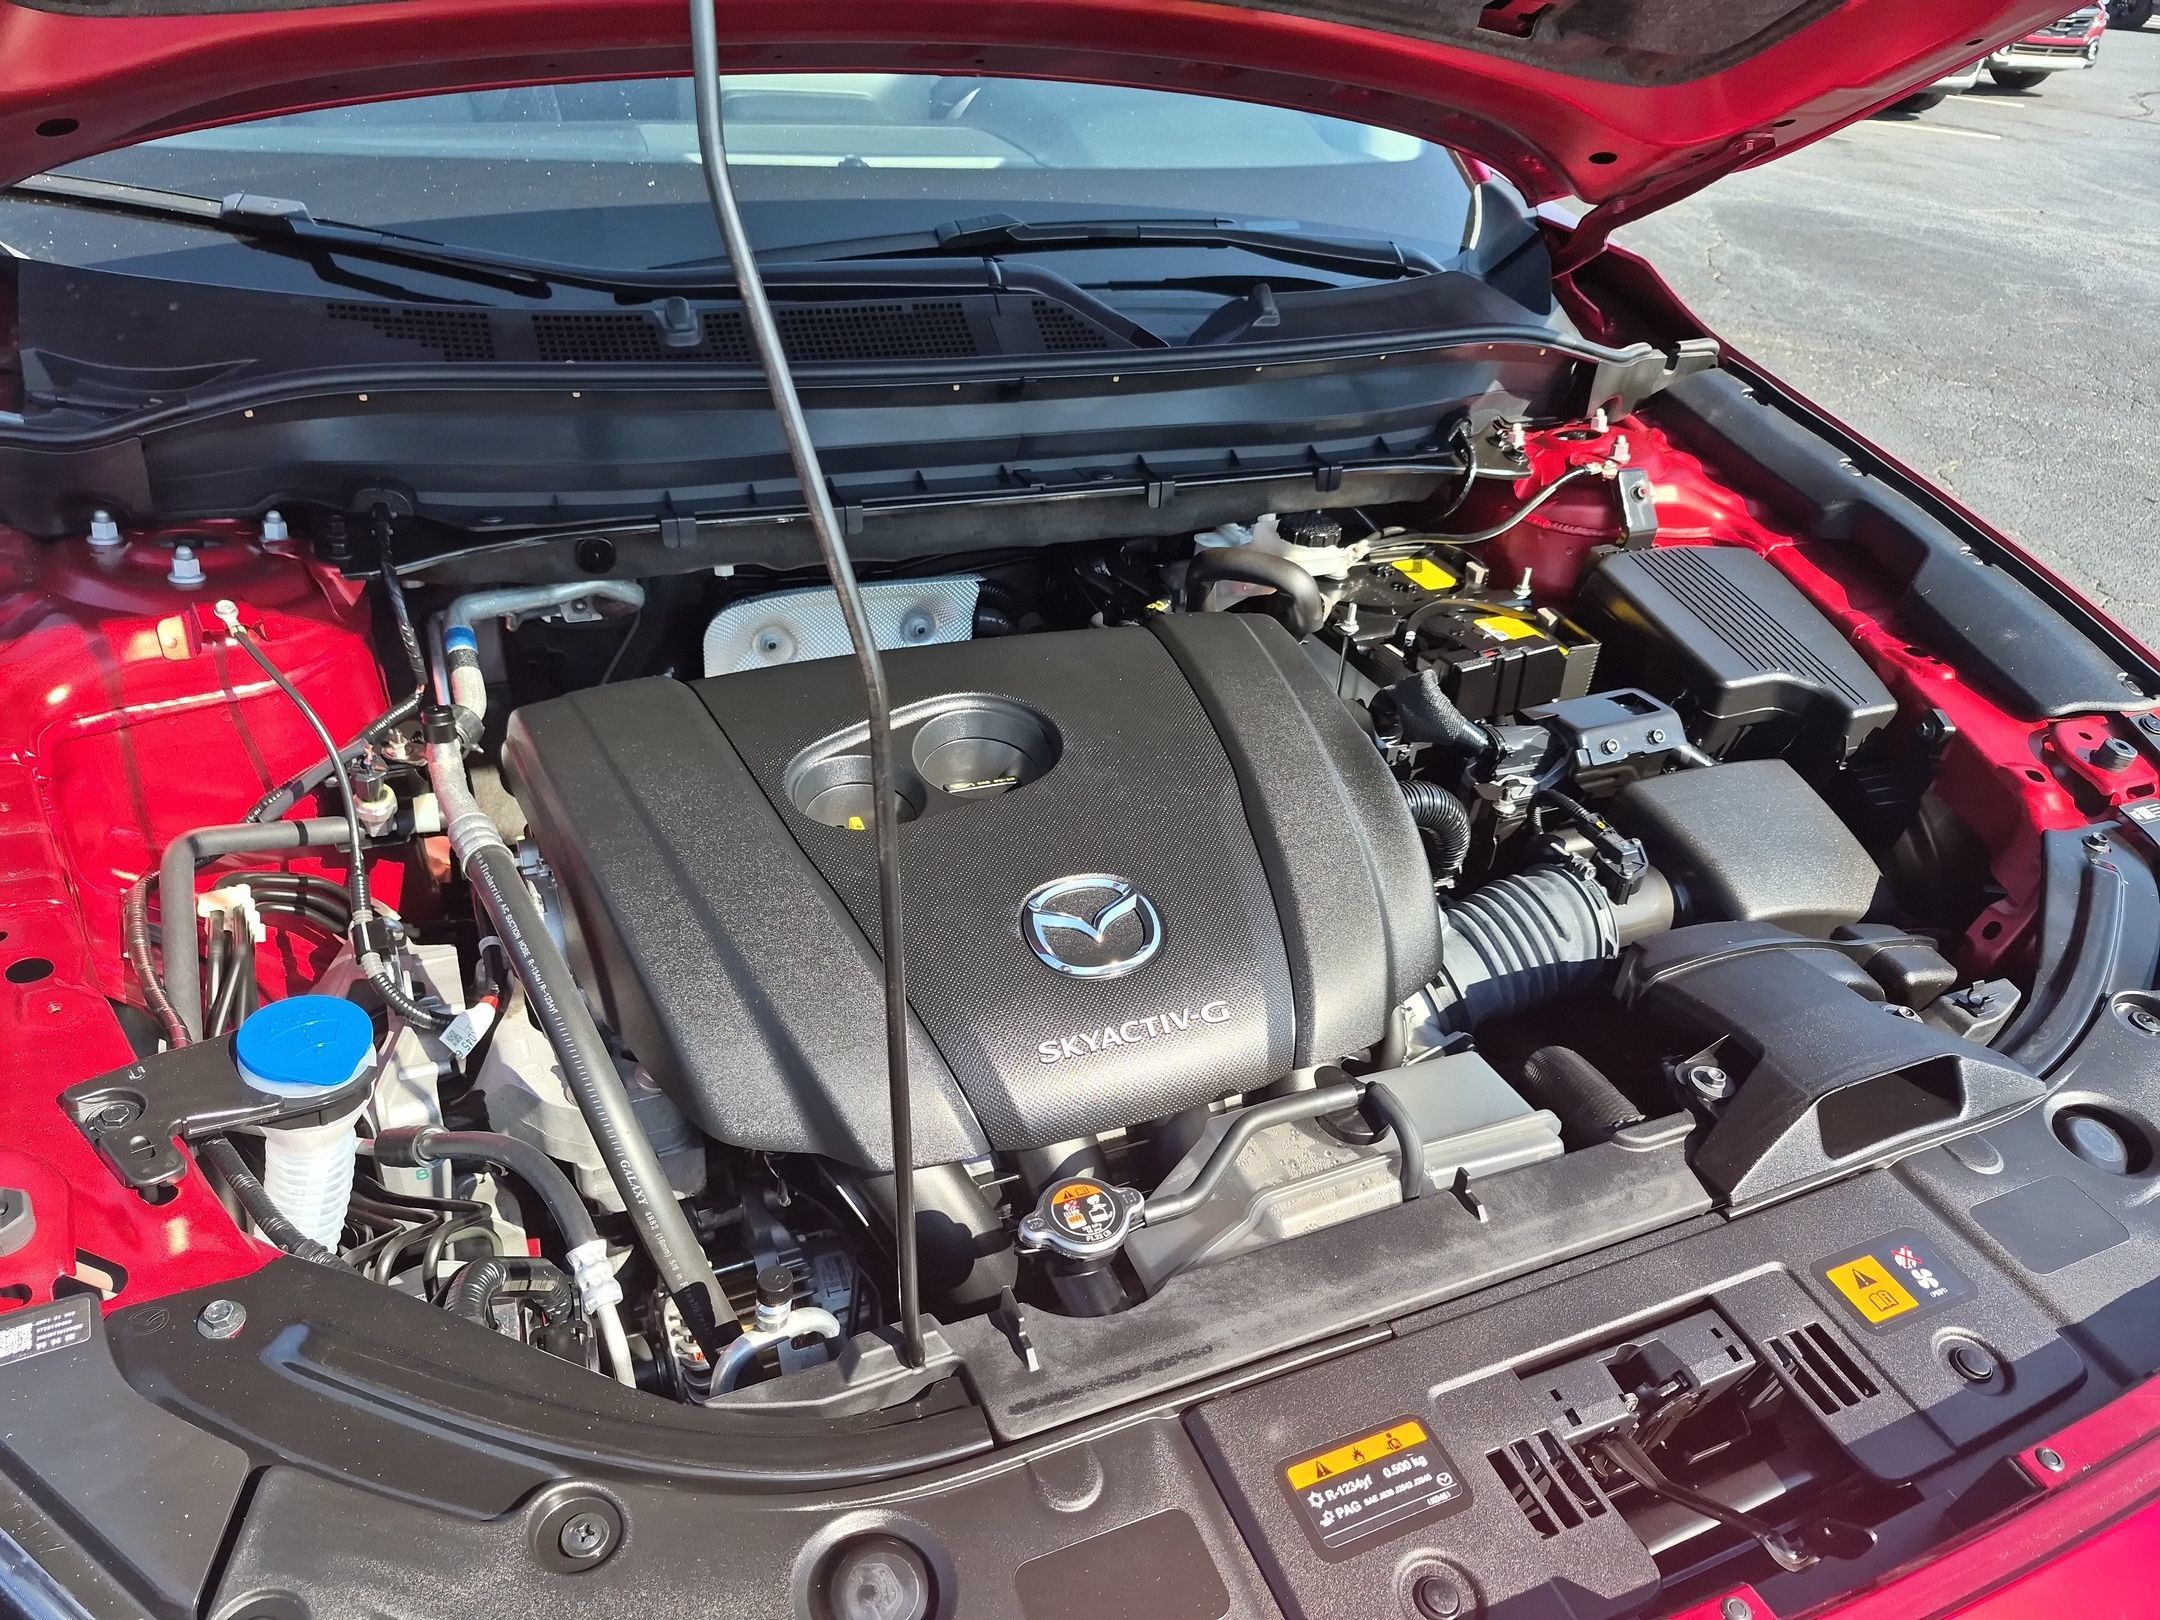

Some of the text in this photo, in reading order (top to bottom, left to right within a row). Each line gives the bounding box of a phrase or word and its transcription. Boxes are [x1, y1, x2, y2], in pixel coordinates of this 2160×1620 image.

[505, 912, 522, 940] SUCTION
[519, 940, 532, 958] HOSE
[1037, 1000, 1231, 1064] SKYACTIV-G
[620, 1158, 649, 1206] GALAXY
[644, 1211, 660, 1231] 4882
[1324, 1455, 1428, 1502] R-1234yf 0.500 kg
[1335, 1500, 1362, 1519] PAG
